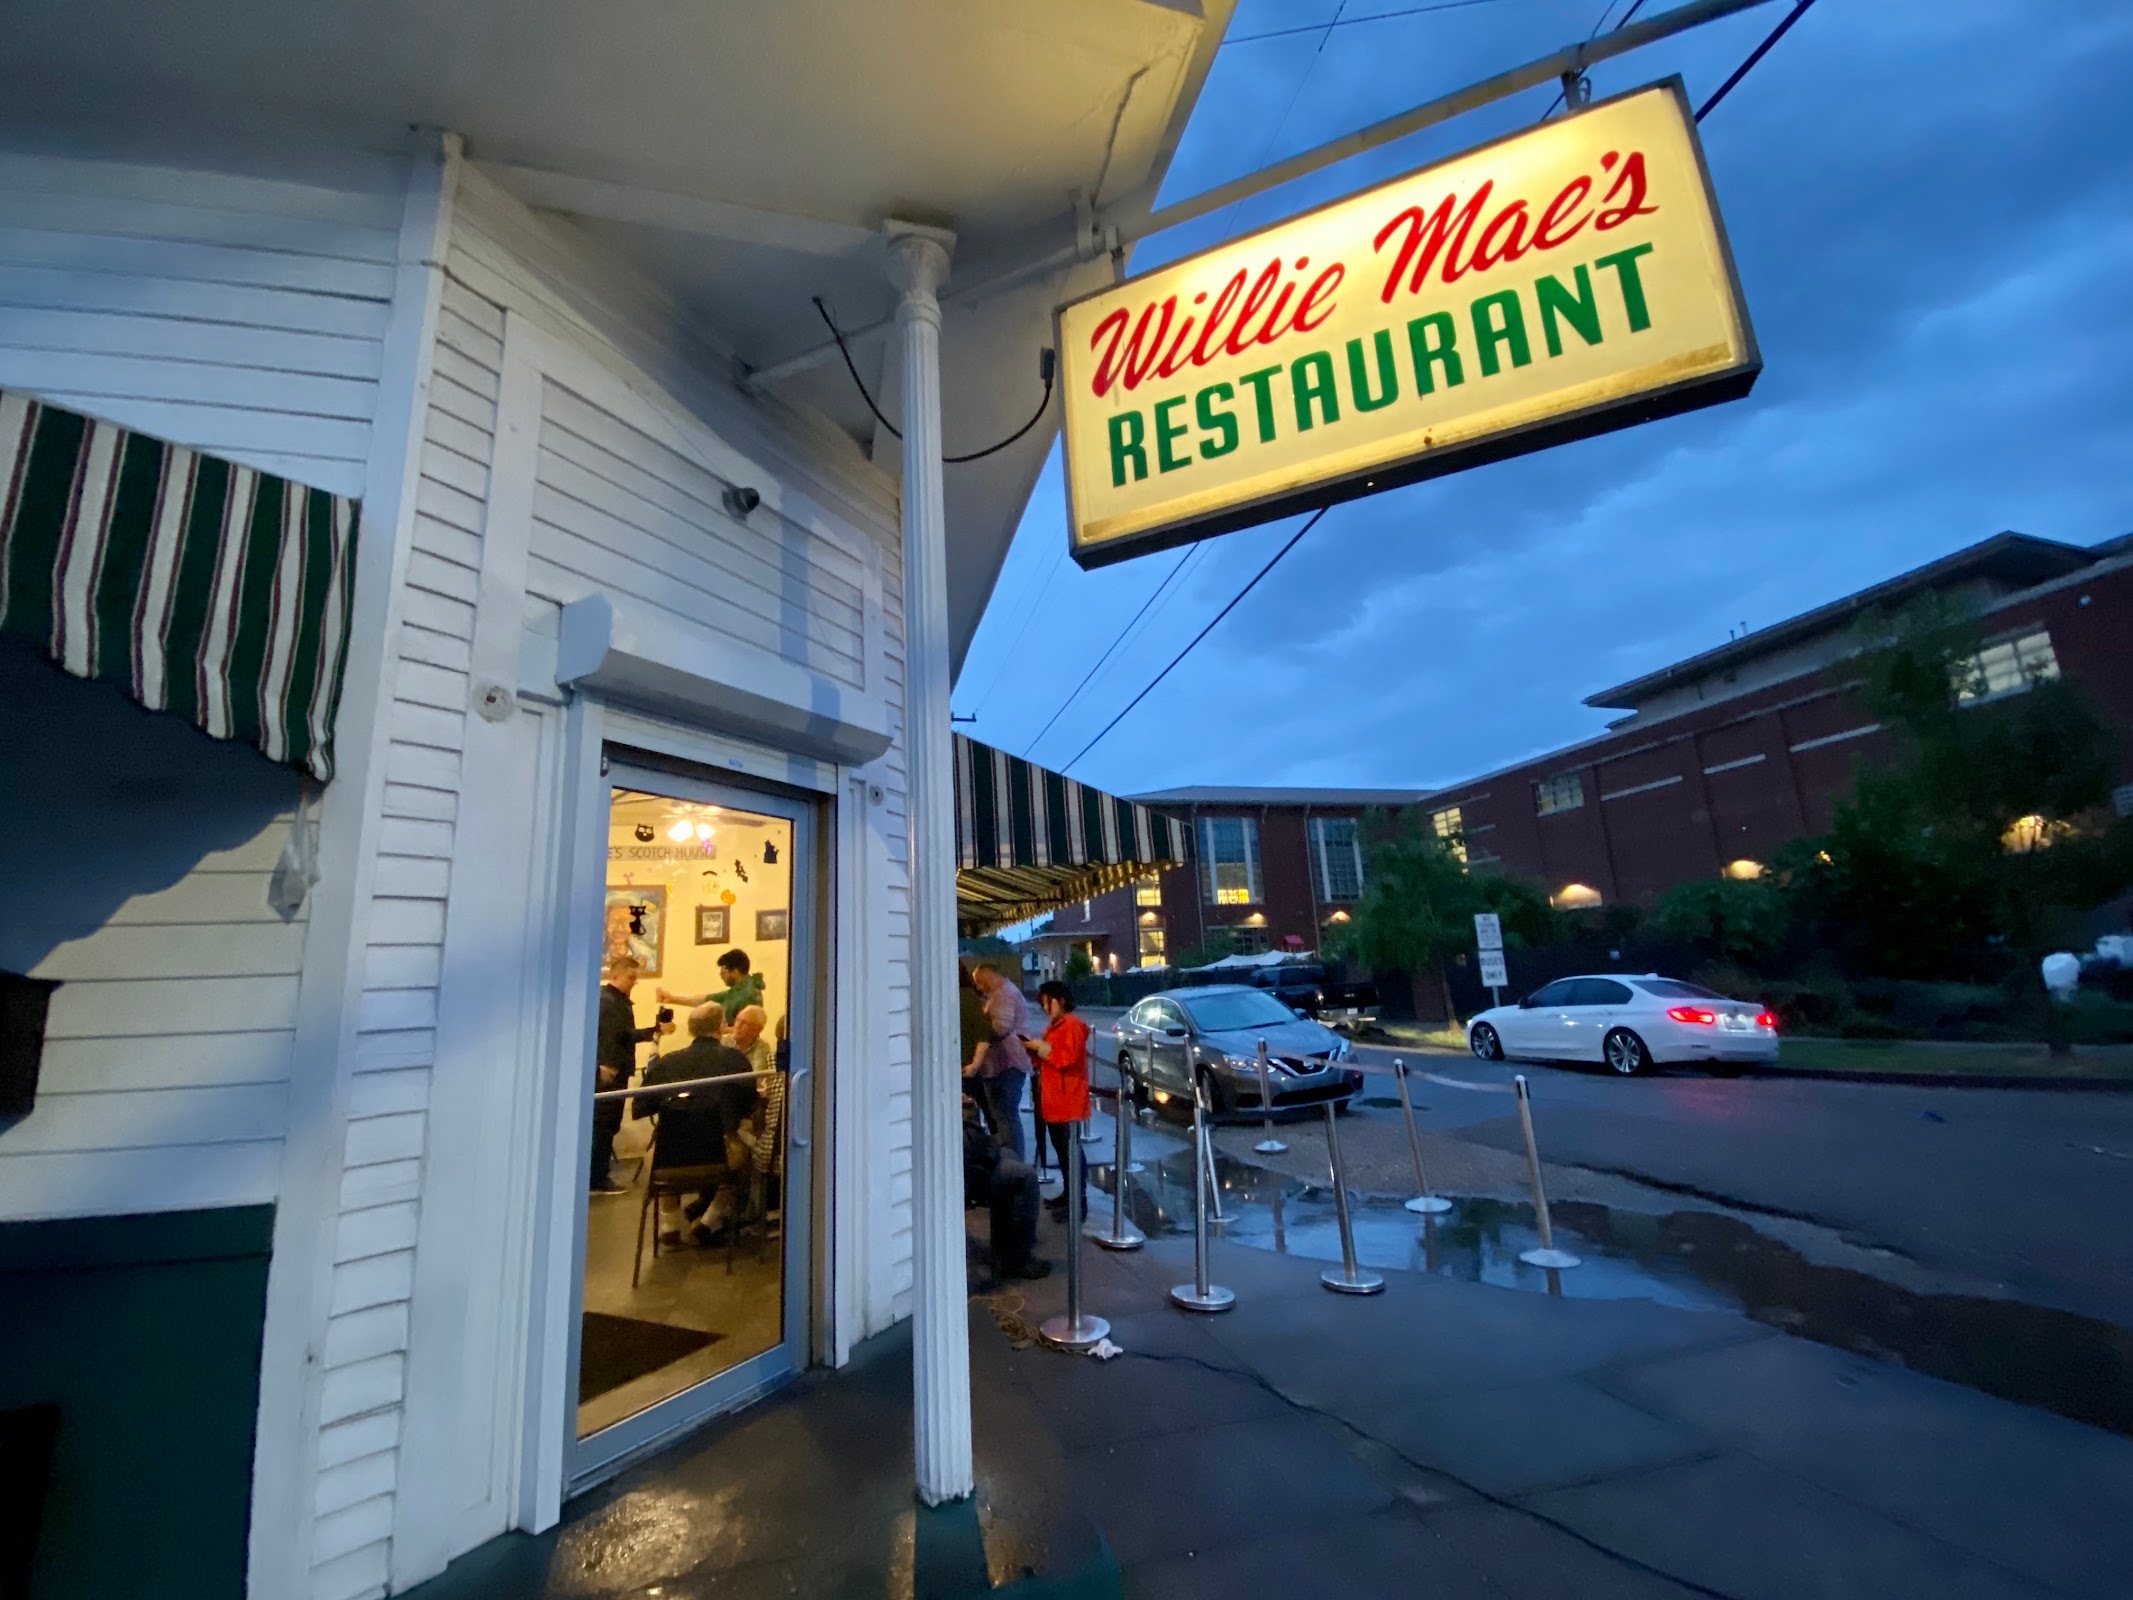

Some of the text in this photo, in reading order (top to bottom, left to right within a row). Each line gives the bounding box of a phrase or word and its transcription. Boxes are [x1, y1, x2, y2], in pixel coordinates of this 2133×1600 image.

[1090, 150, 1660, 398] Willie Mae's
[1108, 241, 1655, 488] RESTAURANT
[629, 846, 671, 859] SCOTCH
